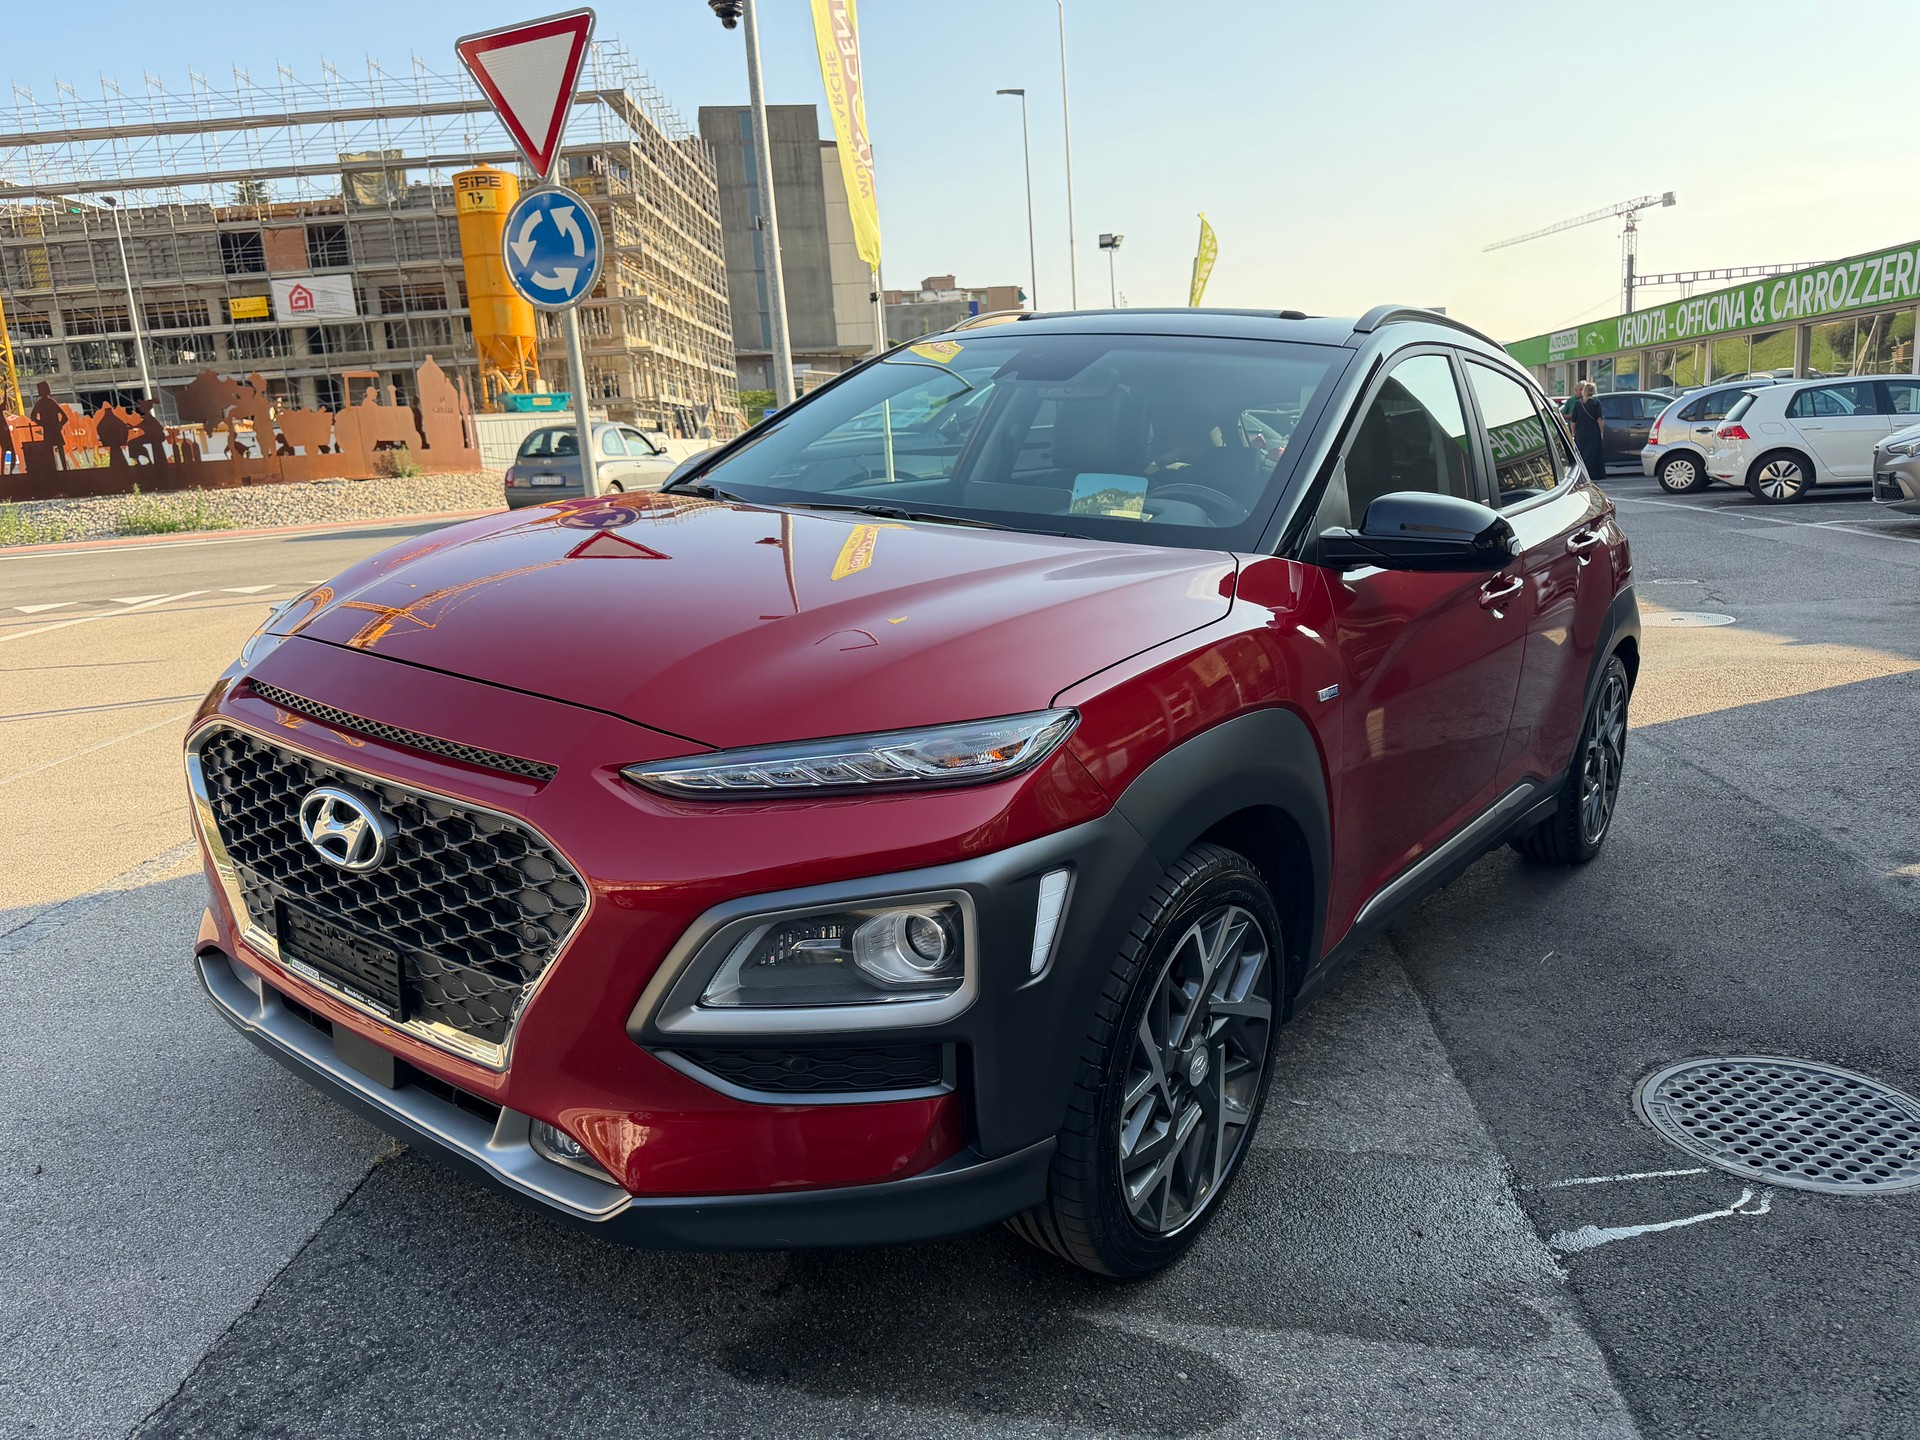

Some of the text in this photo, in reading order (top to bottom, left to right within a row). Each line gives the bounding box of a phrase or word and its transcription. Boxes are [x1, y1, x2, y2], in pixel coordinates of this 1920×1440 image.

[1616, 309, 1667, 348] VENDITA
[1676, 290, 1746, 337] OFFICINA
[1750, 285, 1765, 324] &
[1770, 248, 1920, 320] CARROZZERI
[1551, 332, 1577, 348] AUTO CENTRO
